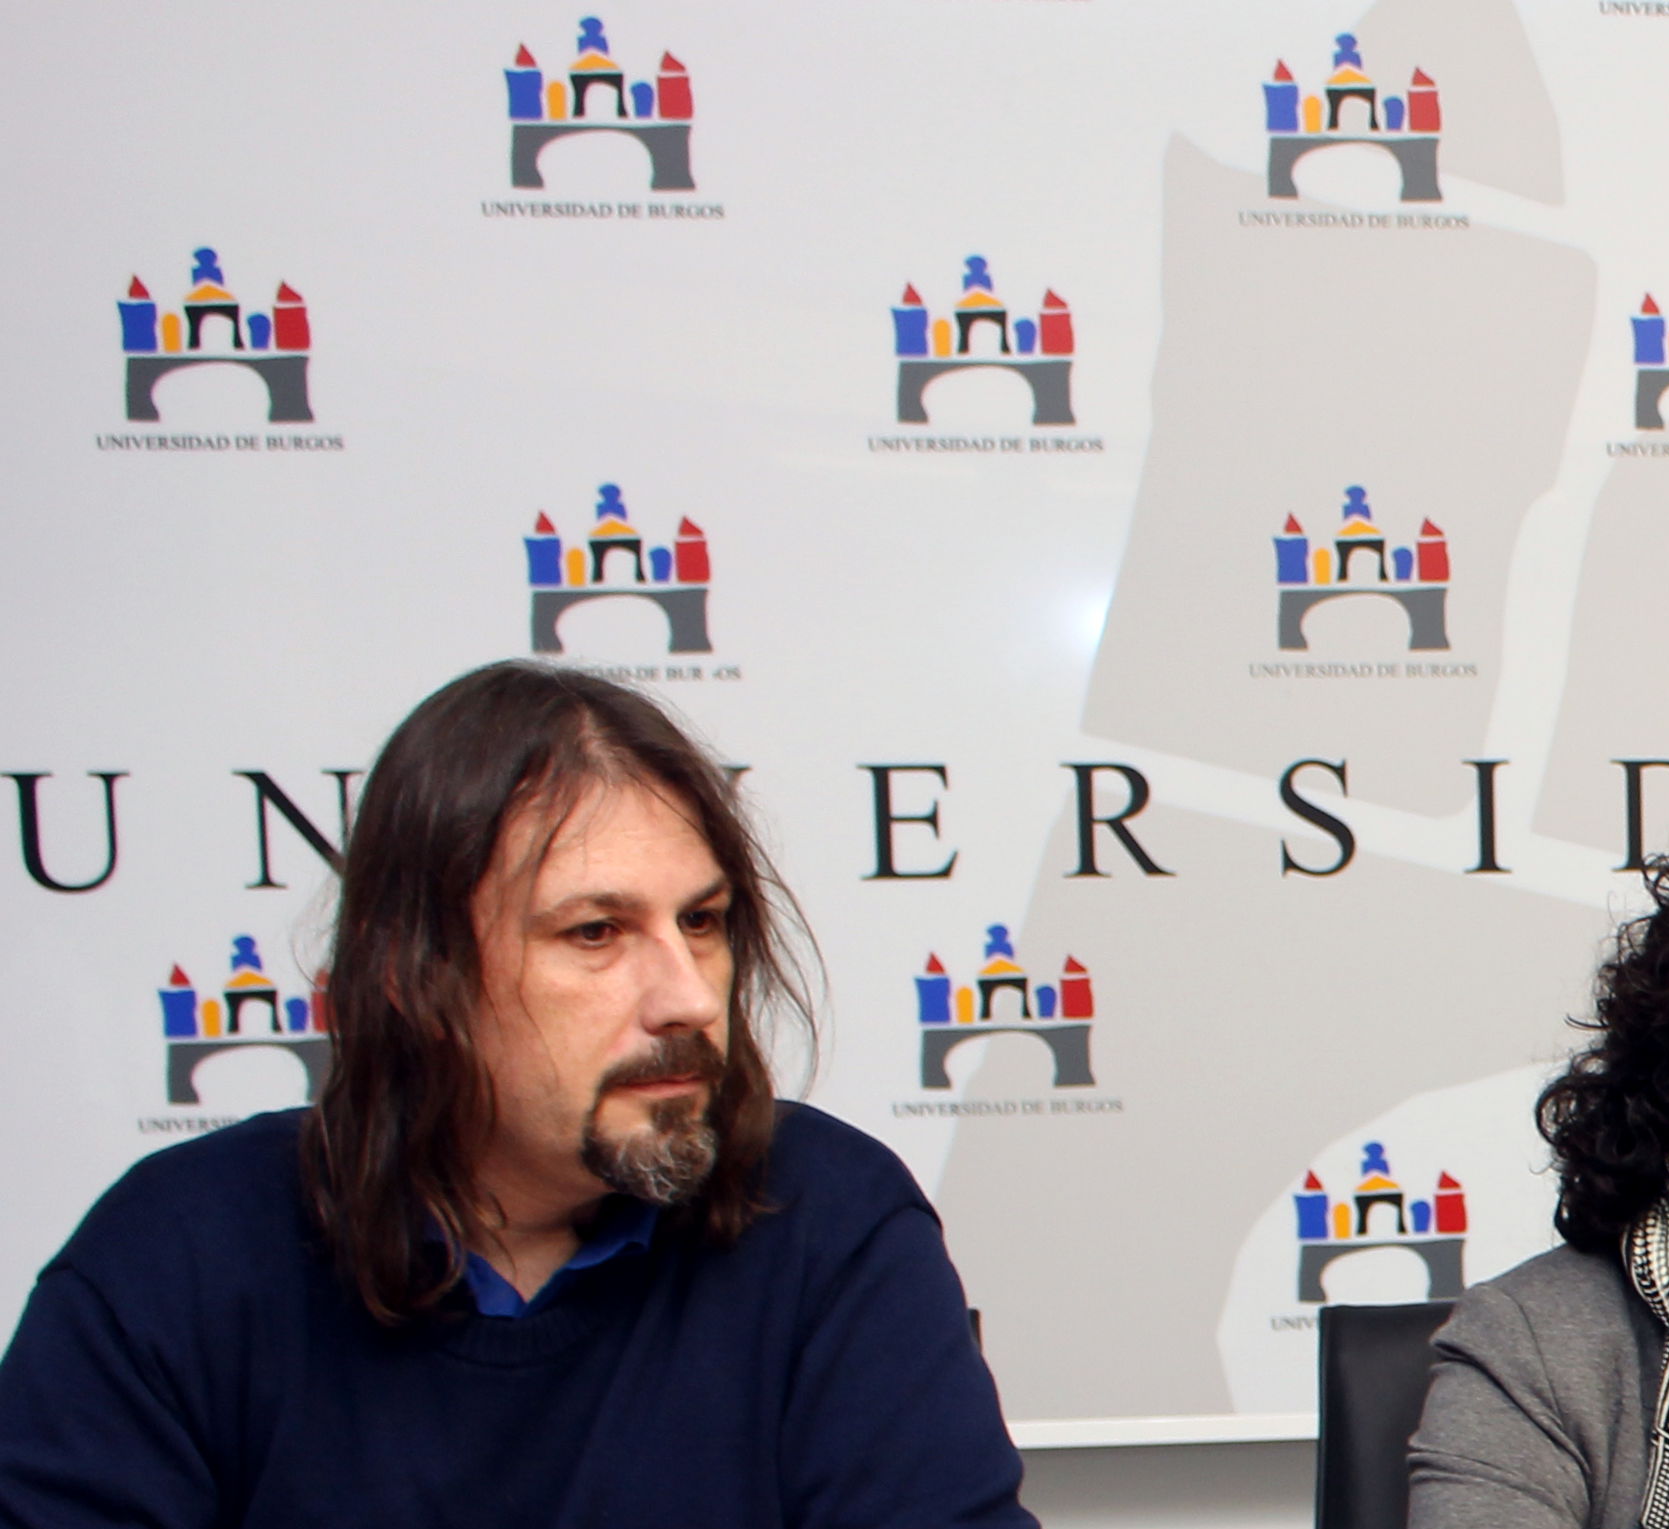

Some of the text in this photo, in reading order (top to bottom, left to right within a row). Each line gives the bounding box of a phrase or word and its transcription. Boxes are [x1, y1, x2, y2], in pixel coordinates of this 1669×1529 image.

[480, 202, 726, 219] UNIVERSIDAD DE BURGOS
[1237, 212, 1471, 229] UNIVERSIDAD DE BURGOS
[95, 435, 346, 451] UNIVERSIDAD DE BURGOS
[866, 437, 1105, 453] UNIVERSIDAD DE BURGOS
[1248, 663, 1479, 678] UNIVERSIDAD DE BURGOS
[891, 1100, 1124, 1116] UNIVERSIDAD DE BURGOS
